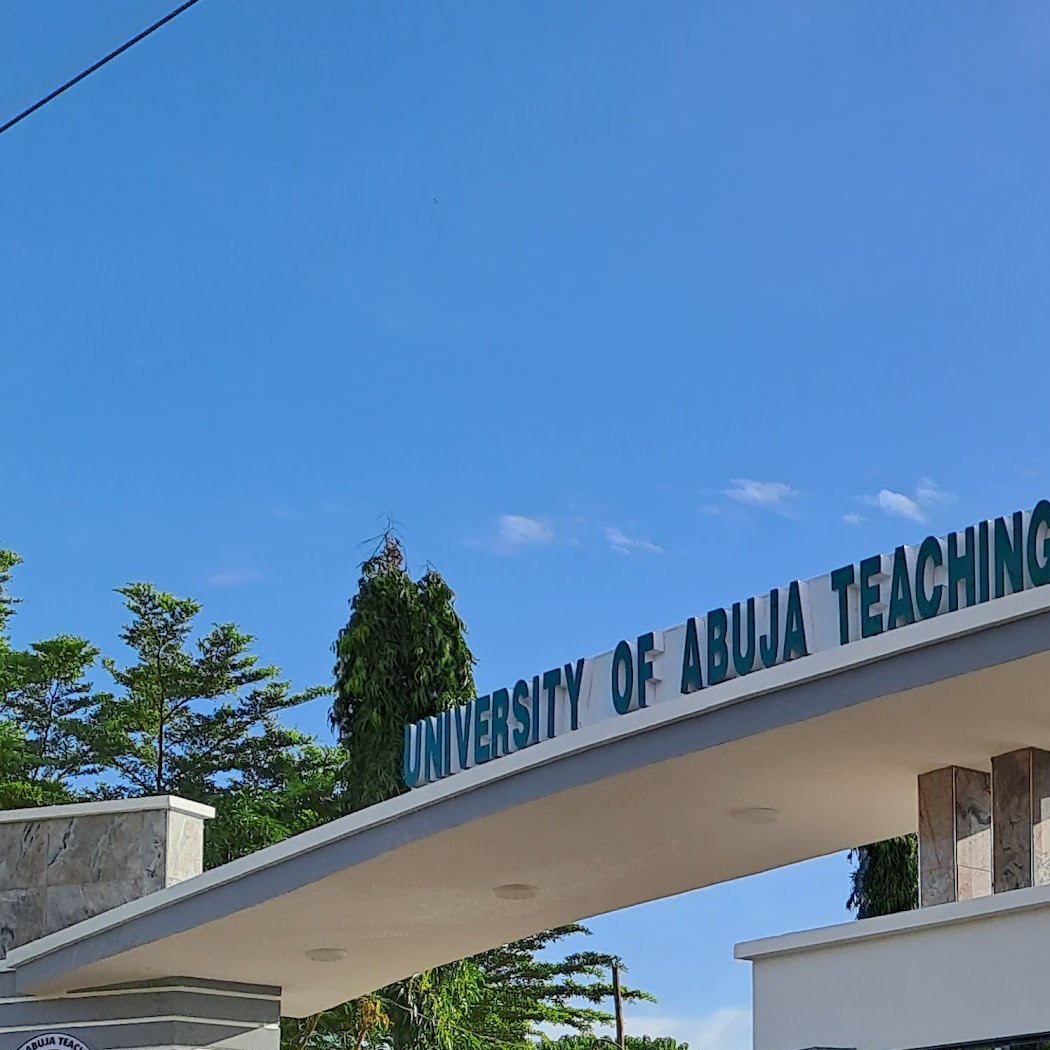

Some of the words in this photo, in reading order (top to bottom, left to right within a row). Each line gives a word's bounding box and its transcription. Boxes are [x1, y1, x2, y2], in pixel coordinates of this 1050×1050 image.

[403, 657, 585, 788] UNIVERSITY
[611, 631, 656, 715] OF
[681, 580, 809, 694] ABUJA
